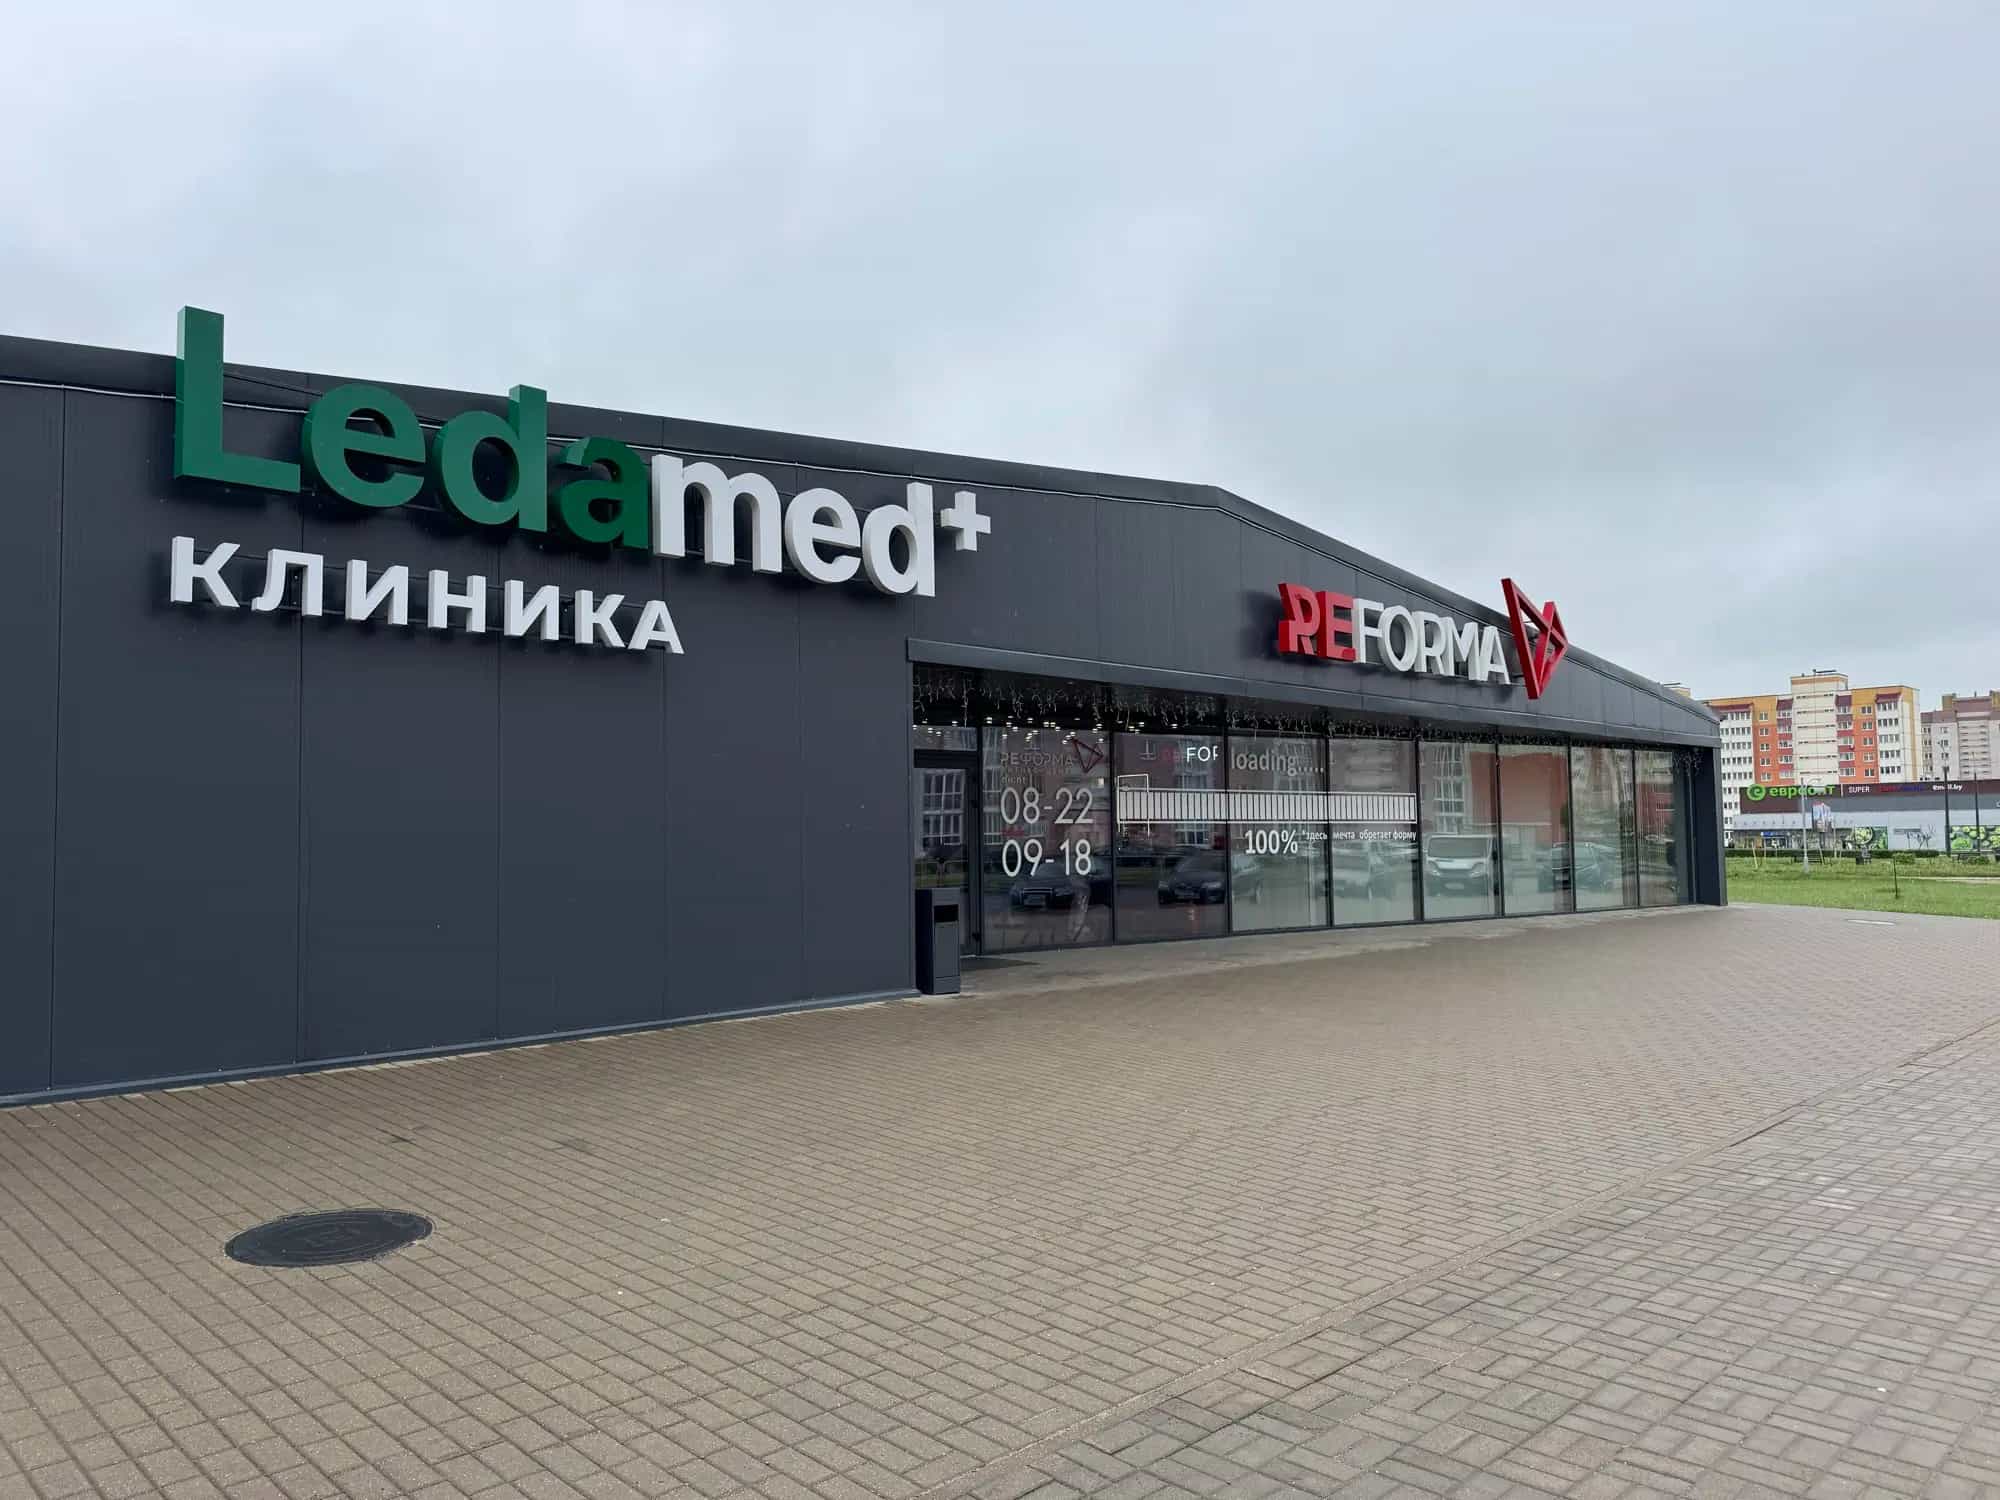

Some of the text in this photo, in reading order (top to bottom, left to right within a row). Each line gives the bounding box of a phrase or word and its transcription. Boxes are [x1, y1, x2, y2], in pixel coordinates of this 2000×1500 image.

[170, 535, 685, 656] КЛИНИКА
[1278, 582, 1511, 685] REFORMA
[1001, 787, 1094, 824] 08-22
[1244, 829, 1298, 855] 100%
[1333, 831, 1356, 840] мечта
[1359, 829, 1391, 841] обретает
[1393, 829, 1417, 841] форму
[1002, 839, 1092, 876] 09-18
